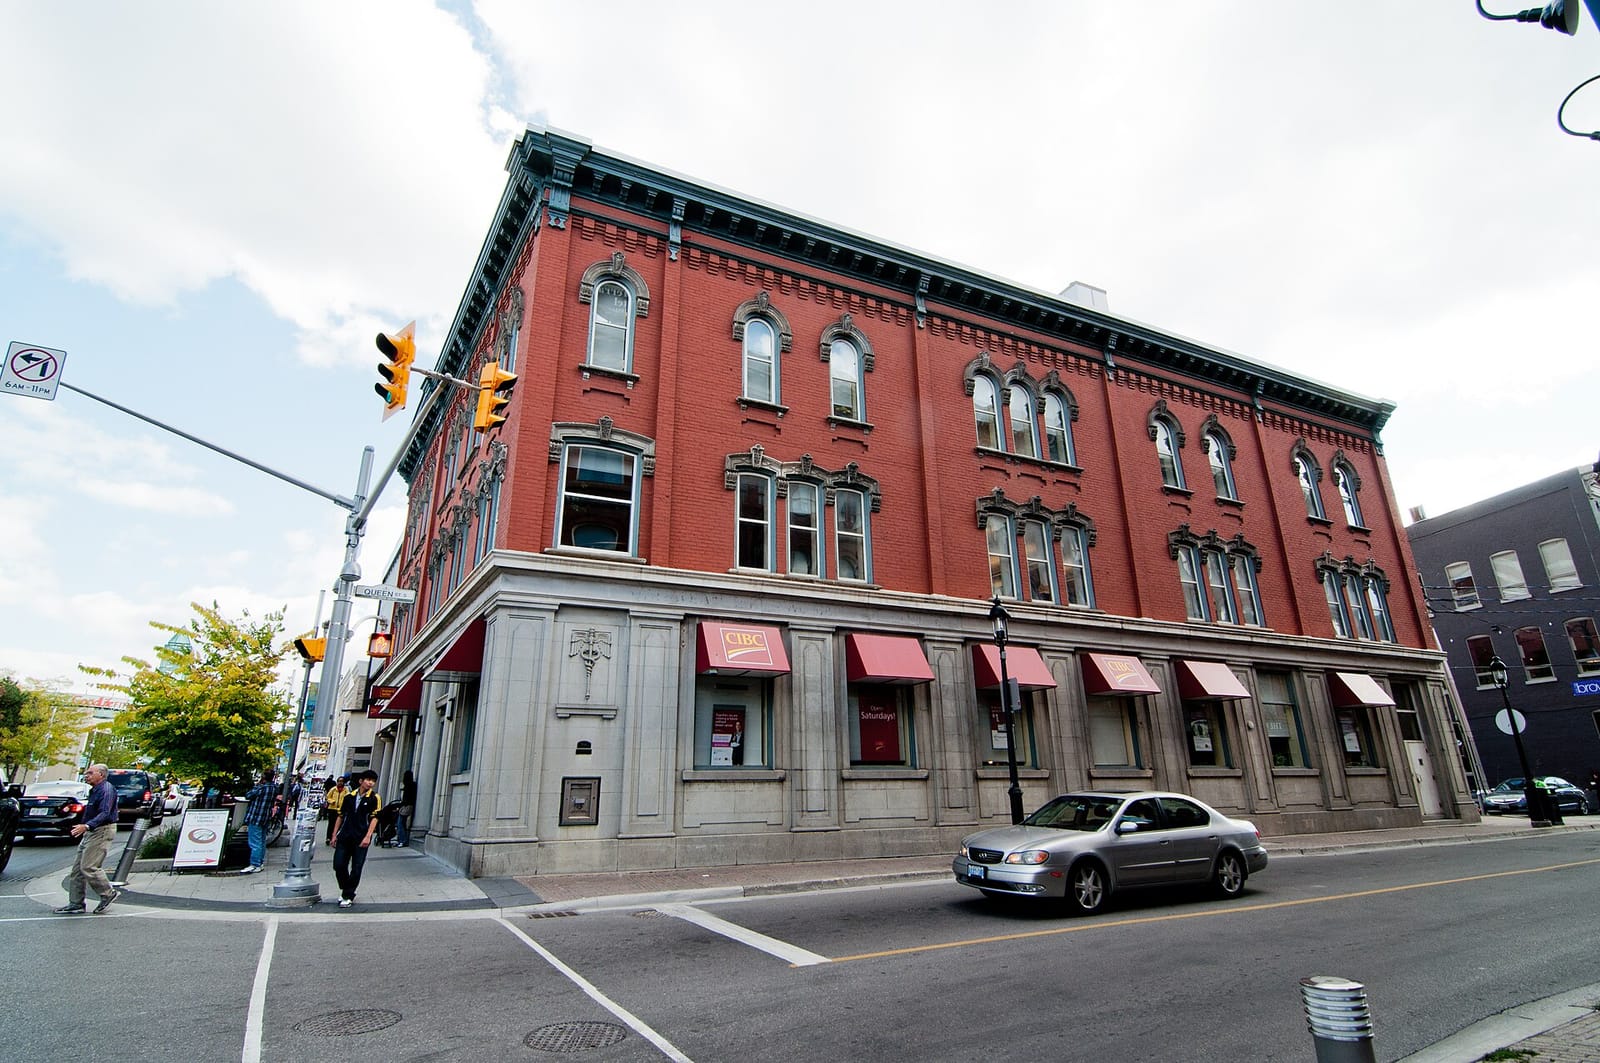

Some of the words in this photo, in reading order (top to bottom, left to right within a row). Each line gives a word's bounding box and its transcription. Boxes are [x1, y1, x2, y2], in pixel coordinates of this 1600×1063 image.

[364, 588, 394, 598] QUEEN
[725, 631, 765, 647] CIBC
[1107, 661, 1135, 673] CIBC
[860, 711, 896, 722] Saturdays!
